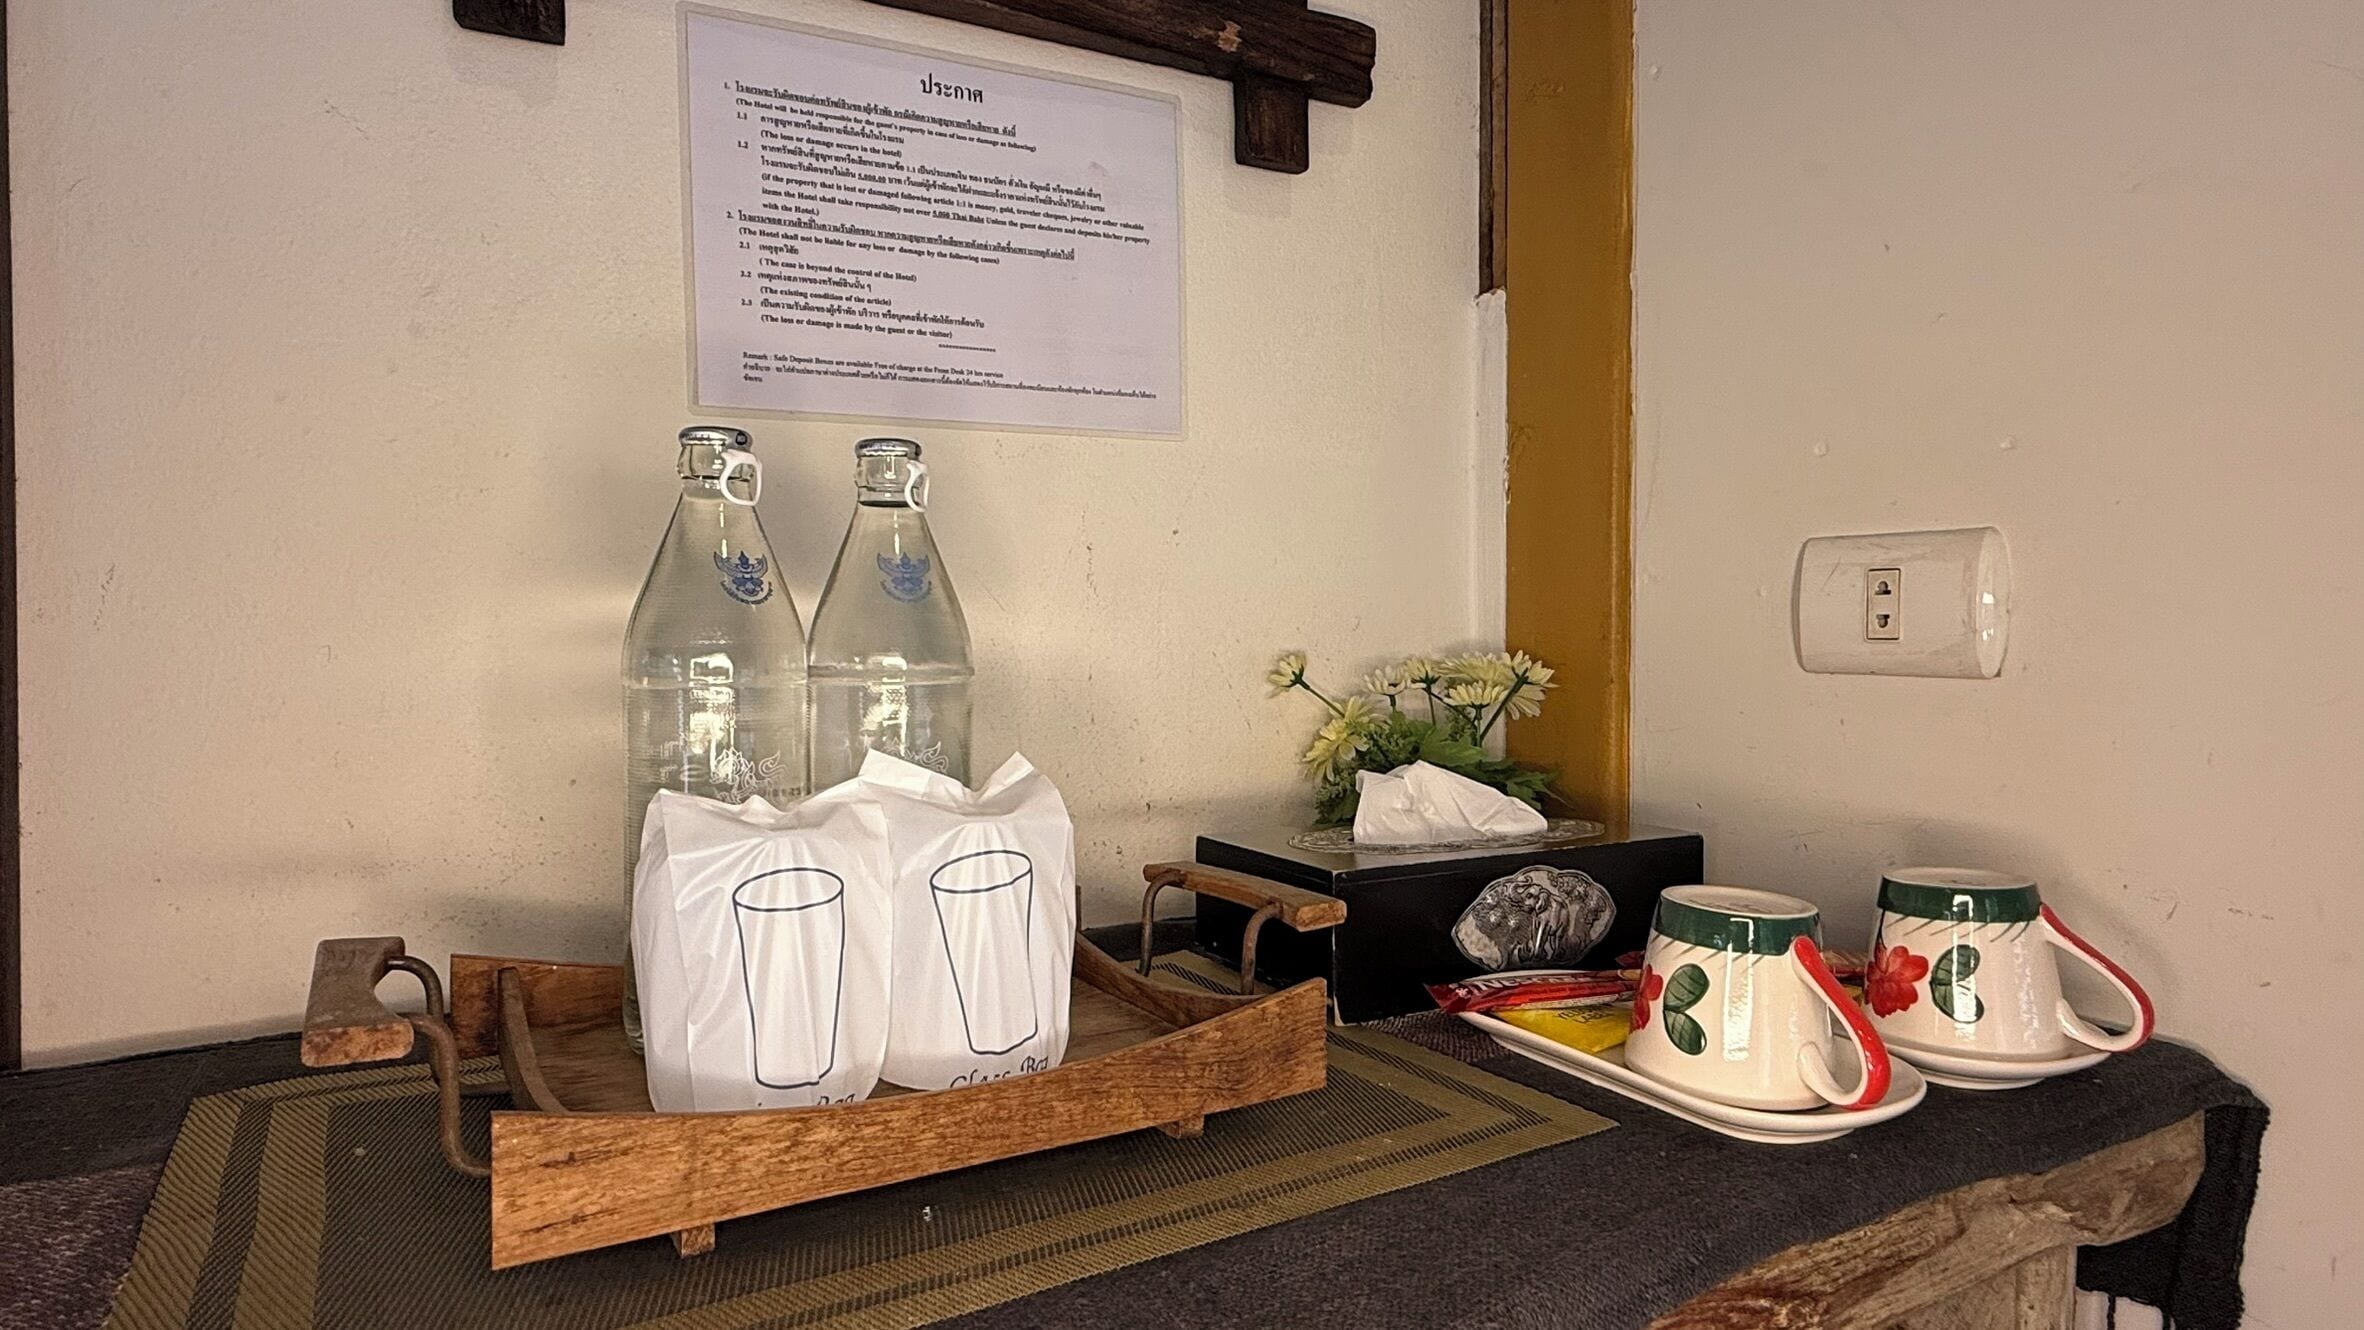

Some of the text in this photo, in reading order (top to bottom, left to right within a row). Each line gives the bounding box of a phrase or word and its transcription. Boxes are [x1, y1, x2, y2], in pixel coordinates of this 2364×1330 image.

[920, 73, 983, 103] ประกาศ
[762, 202, 820, 216] with the Hotel.)
[739, 241, 750, 249] 2.1
[760, 286, 778, 295] (The
[779, 289, 808, 299] existing
[809, 292, 844, 301] condition
[866, 298, 892, 307] article)
